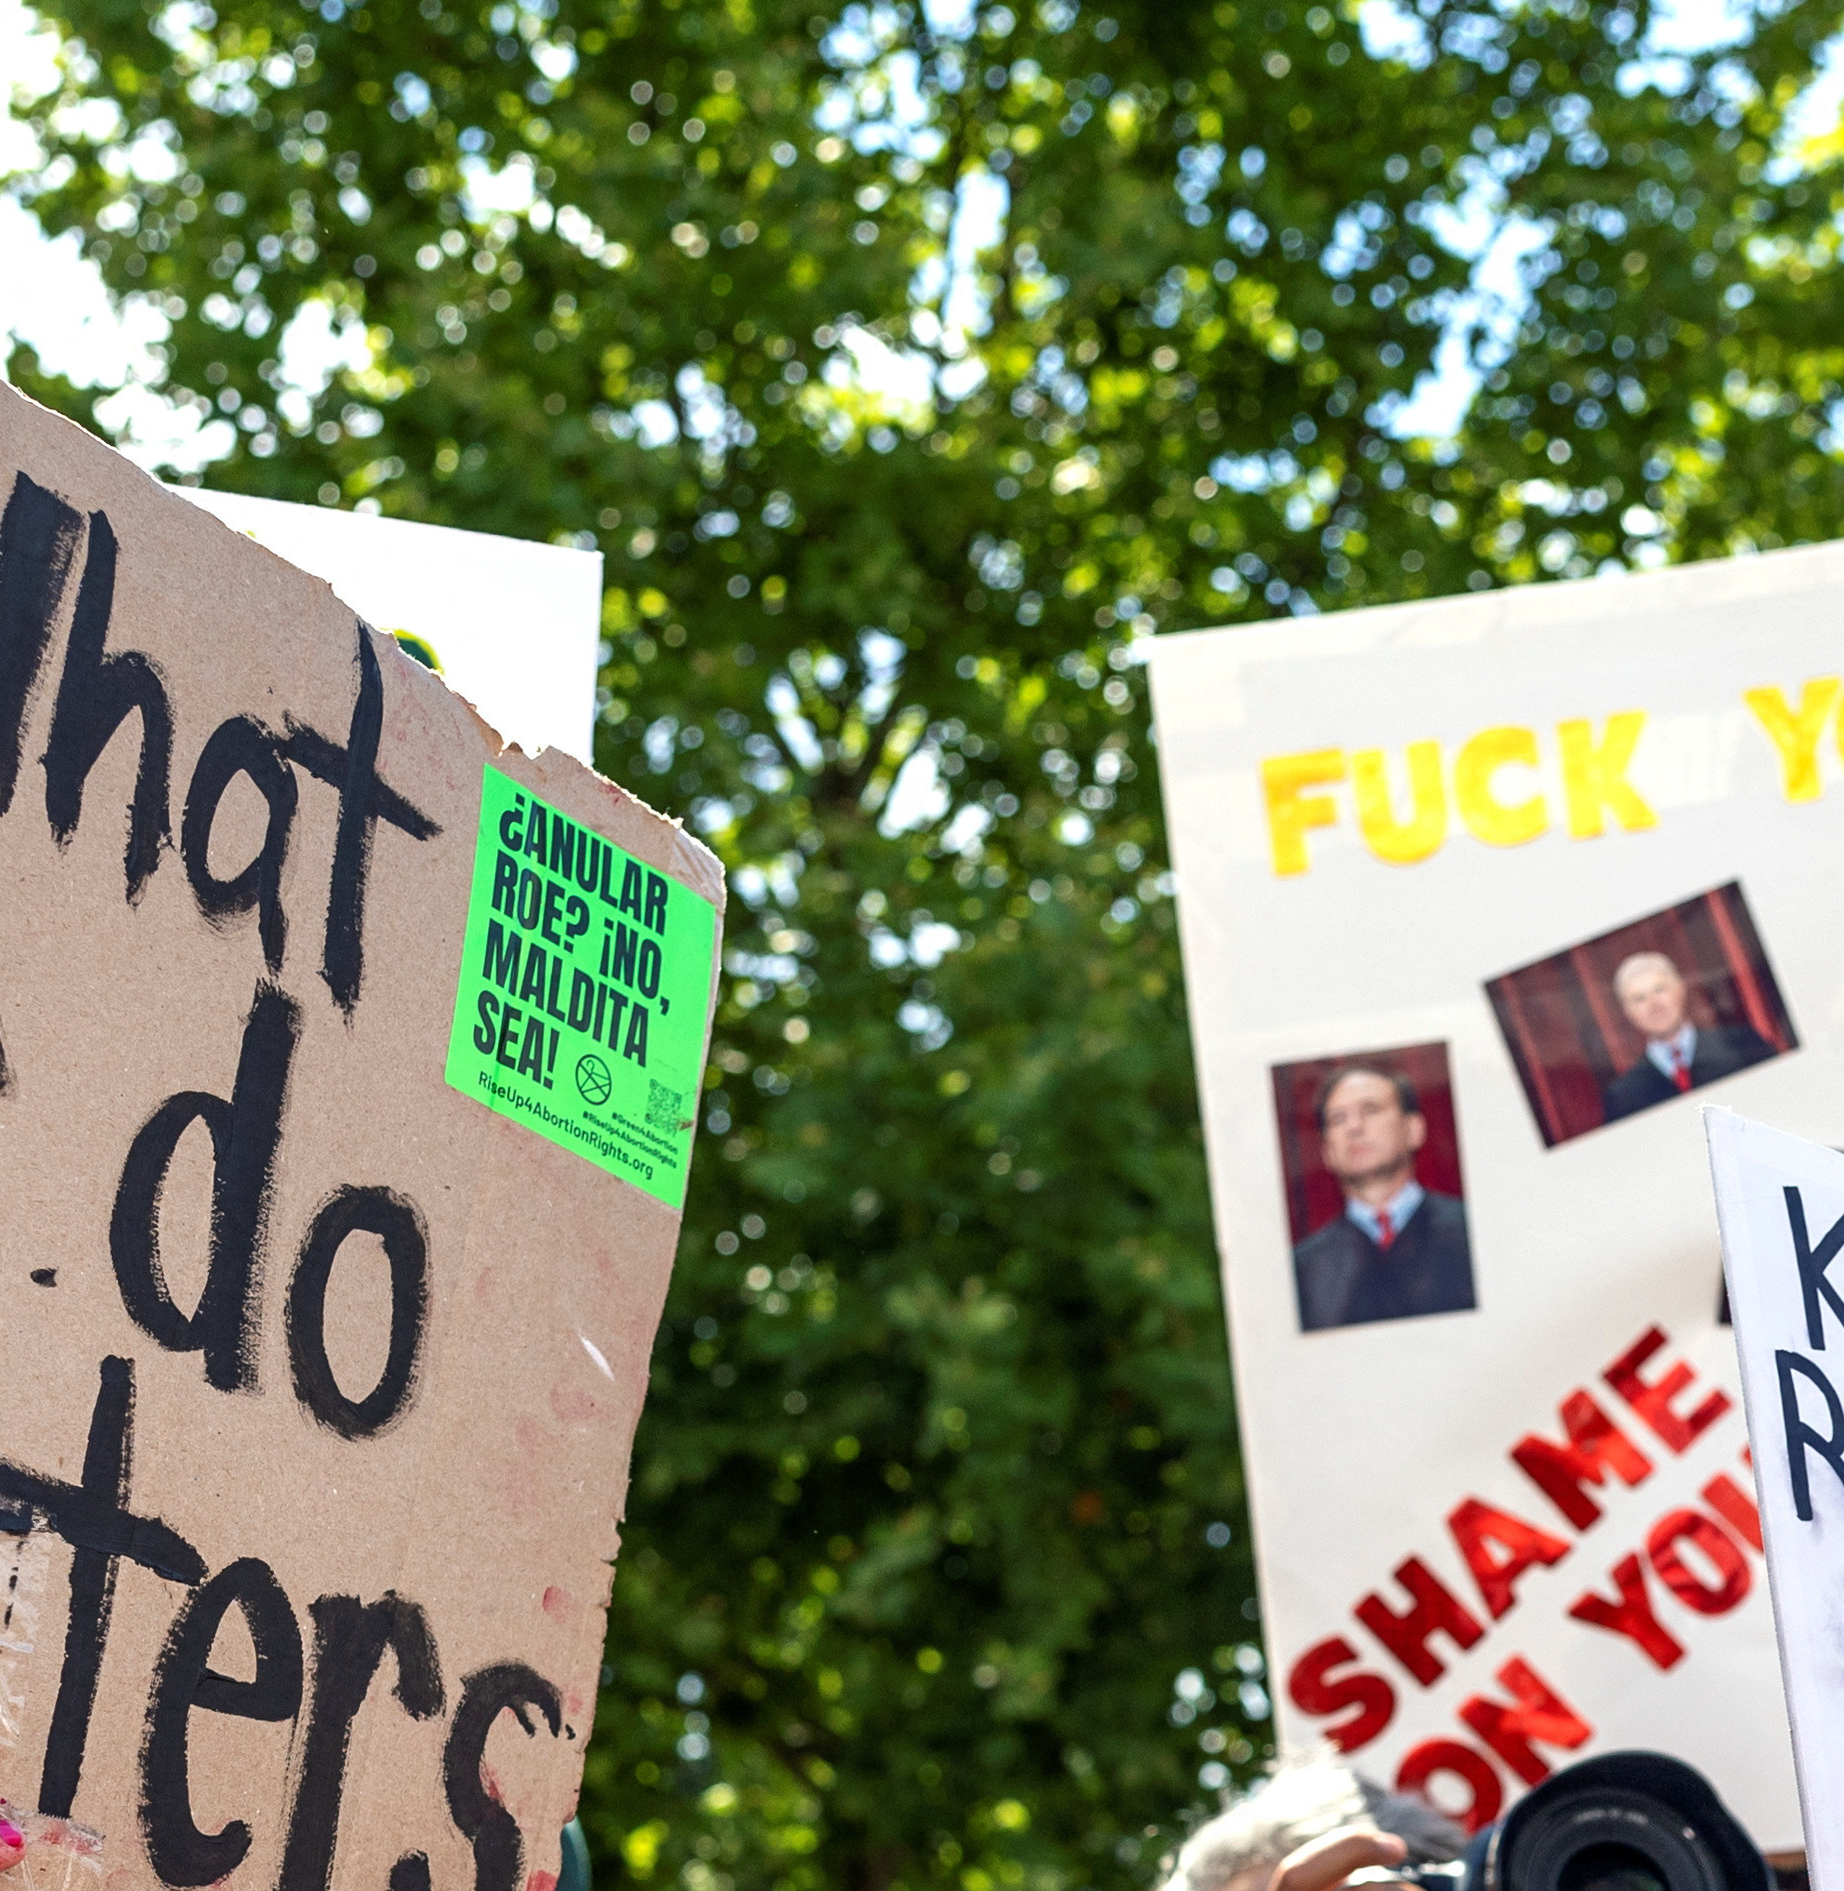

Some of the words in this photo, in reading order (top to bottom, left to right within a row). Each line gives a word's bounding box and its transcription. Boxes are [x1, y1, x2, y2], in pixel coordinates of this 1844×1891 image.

[498, 792, 668, 936] ¿ANULAR
[1260, 709, 1659, 876] FUCK
[482, 918, 648, 1068] MALDITA
[491, 850, 590, 954] ROE?
[599, 917, 671, 1018] ¡NO,
[473, 989, 561, 1091] SEA!
[479, 1070, 654, 1181] RiseUp4AbortionRights.org
[108, 980, 433, 1440] do
[1287, 1322, 1734, 1756] SHAME
[1394, 1653, 1593, 1837] ON
